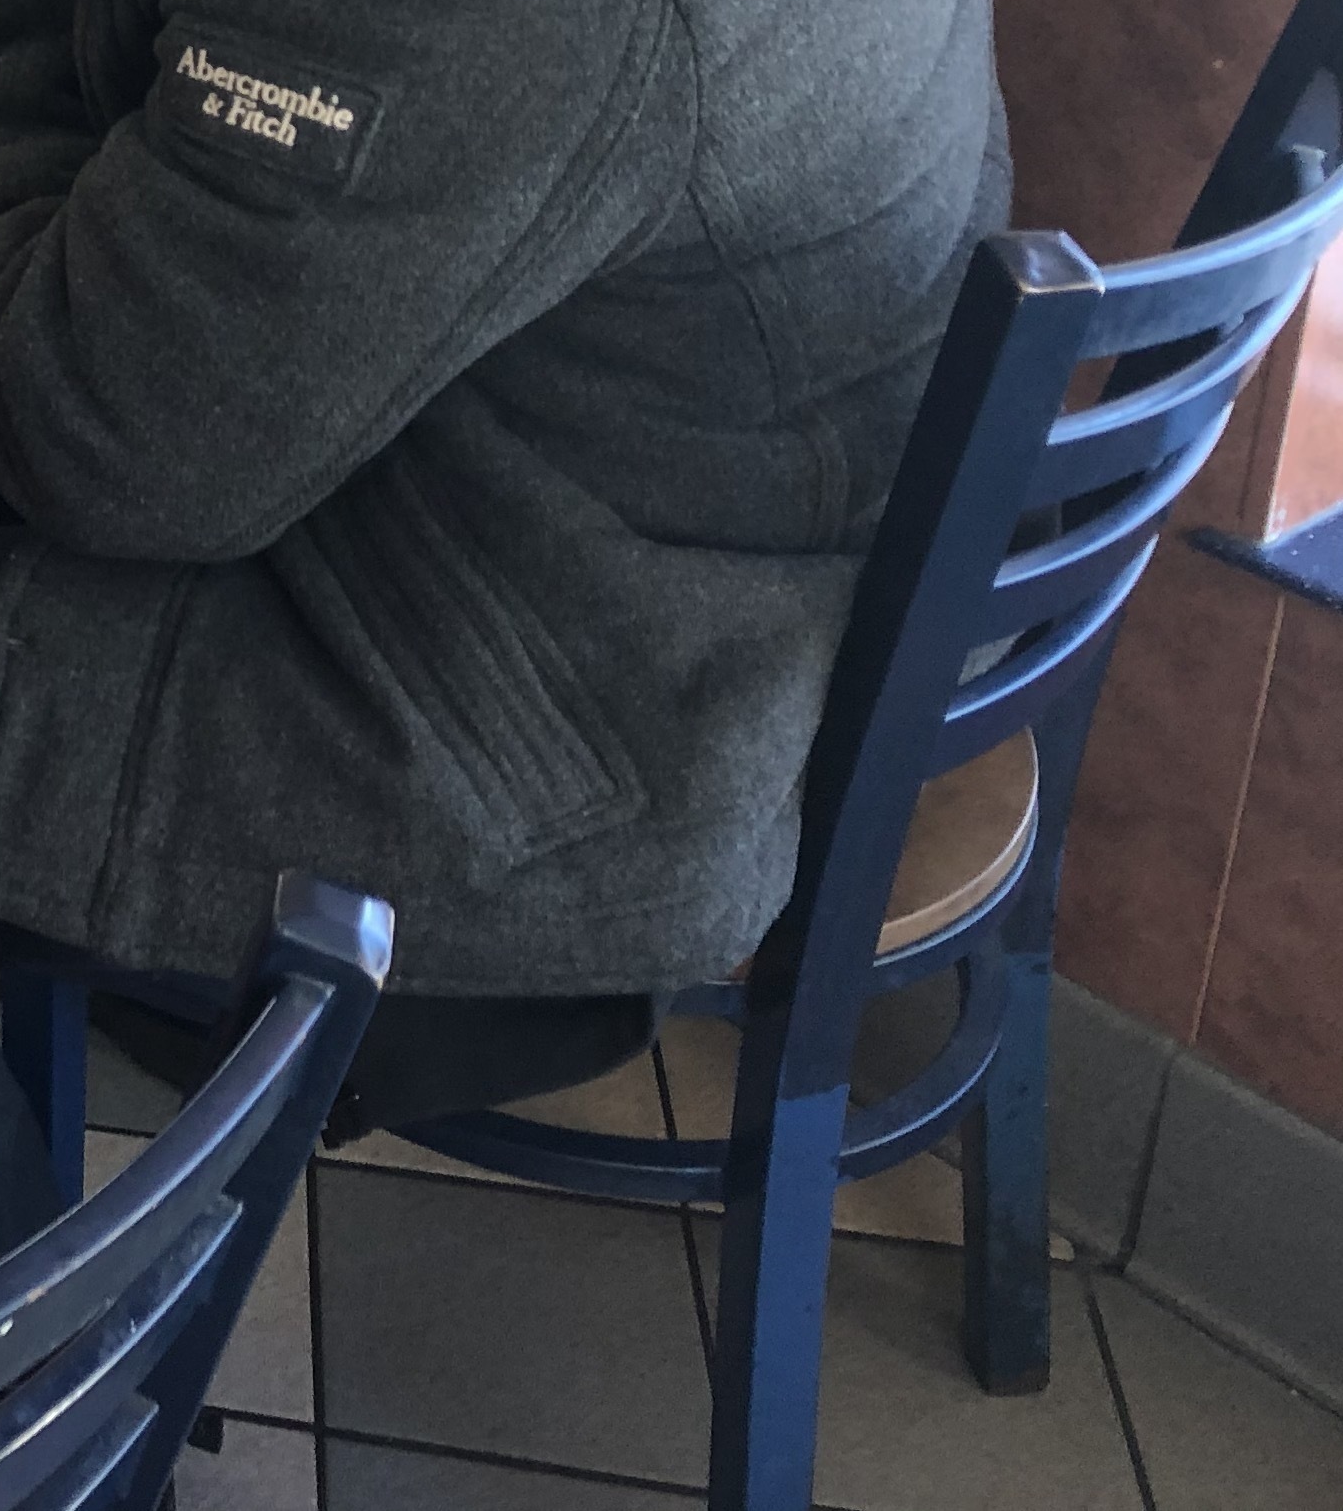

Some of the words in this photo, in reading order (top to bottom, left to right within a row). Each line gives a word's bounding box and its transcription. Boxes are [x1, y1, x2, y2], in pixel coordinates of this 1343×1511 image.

[176, 45, 354, 131] Abercrombie
[202, 92, 224, 117] &
[225, 95, 297, 147] Fitch
